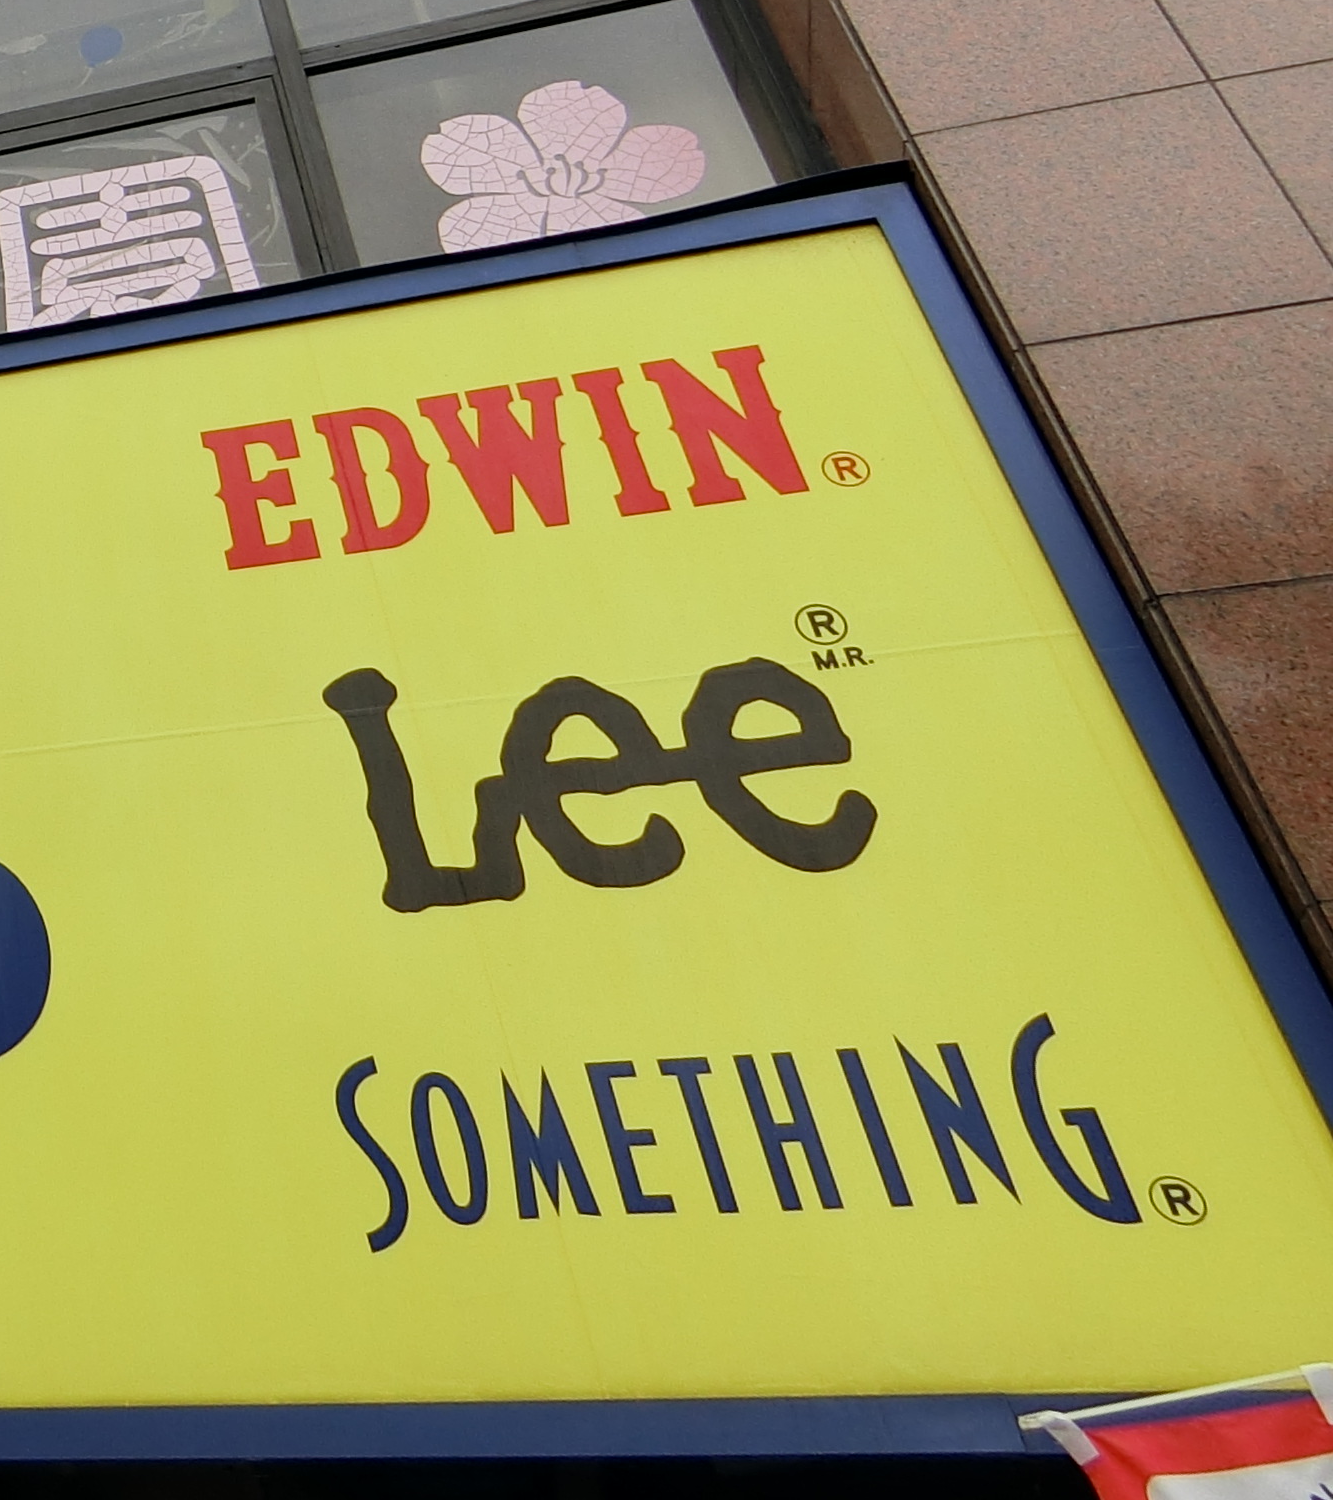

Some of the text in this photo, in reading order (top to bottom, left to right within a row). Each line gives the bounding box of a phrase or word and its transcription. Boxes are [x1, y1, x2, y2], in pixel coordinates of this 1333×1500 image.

[200, 345, 809, 570] EDWIN
[813, 646, 874, 672] M.R.
[322, 657, 877, 912] Lee
[335, 1012, 1142, 1252] SOMETHING
